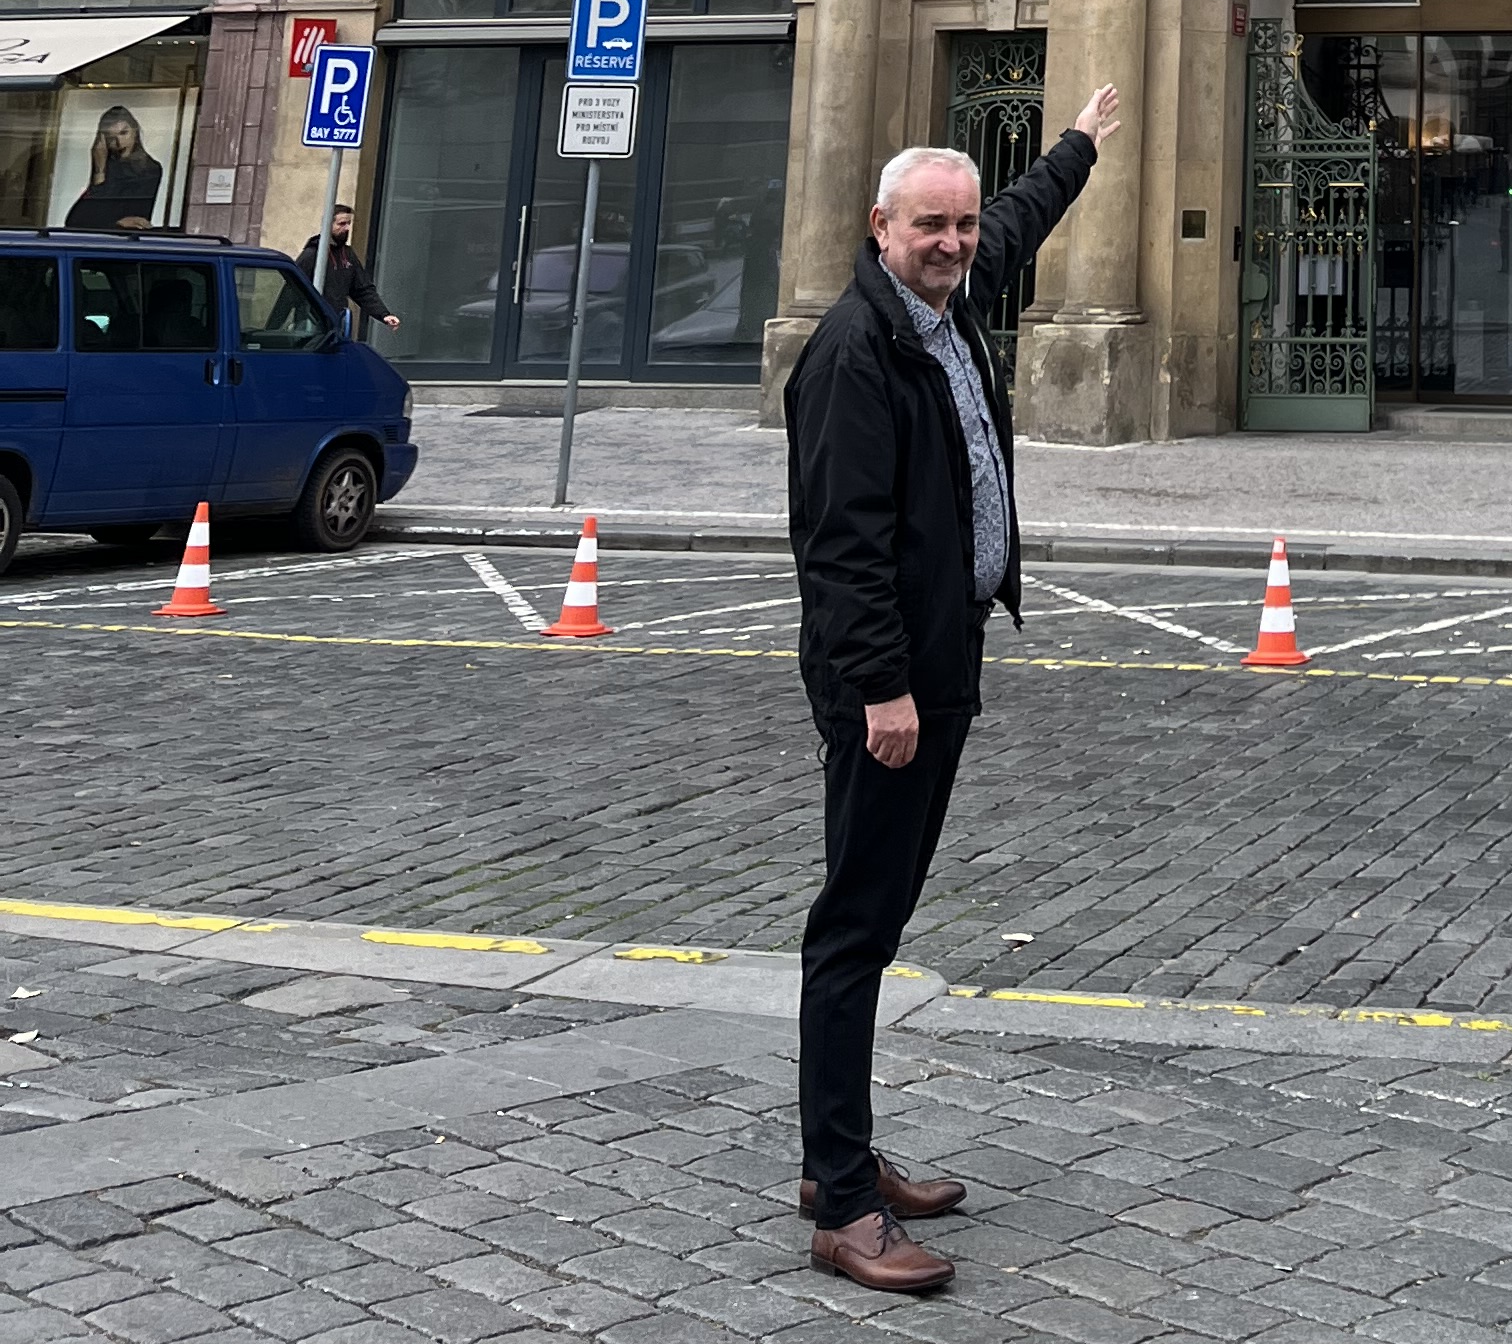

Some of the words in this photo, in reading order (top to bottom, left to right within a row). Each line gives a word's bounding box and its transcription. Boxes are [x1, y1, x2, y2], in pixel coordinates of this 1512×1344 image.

[294, 26, 329, 63] ill
[575, 53, 634, 69] RÉSERVÉ
[320, 58, 358, 114] P
[578, 98, 593, 107] PRO
[333, 128, 357, 140] 5777
[576, 123, 591, 131] PRO
